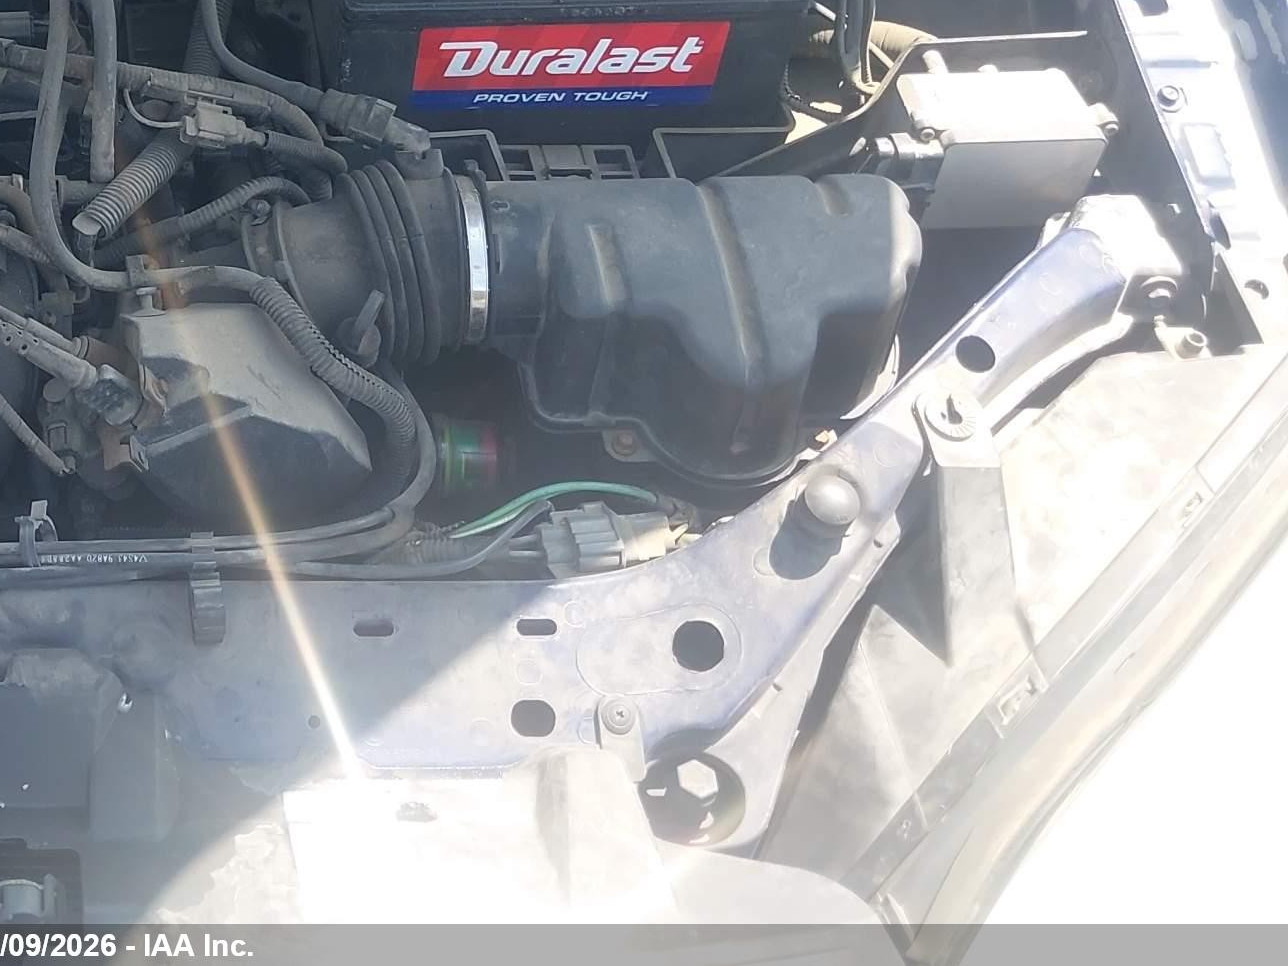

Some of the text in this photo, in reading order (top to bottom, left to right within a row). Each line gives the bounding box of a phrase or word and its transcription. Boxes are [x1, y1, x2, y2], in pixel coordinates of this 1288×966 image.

[440, 37, 702, 77] Duralast
[473, 91, 649, 104] PROVEN TOUGH
